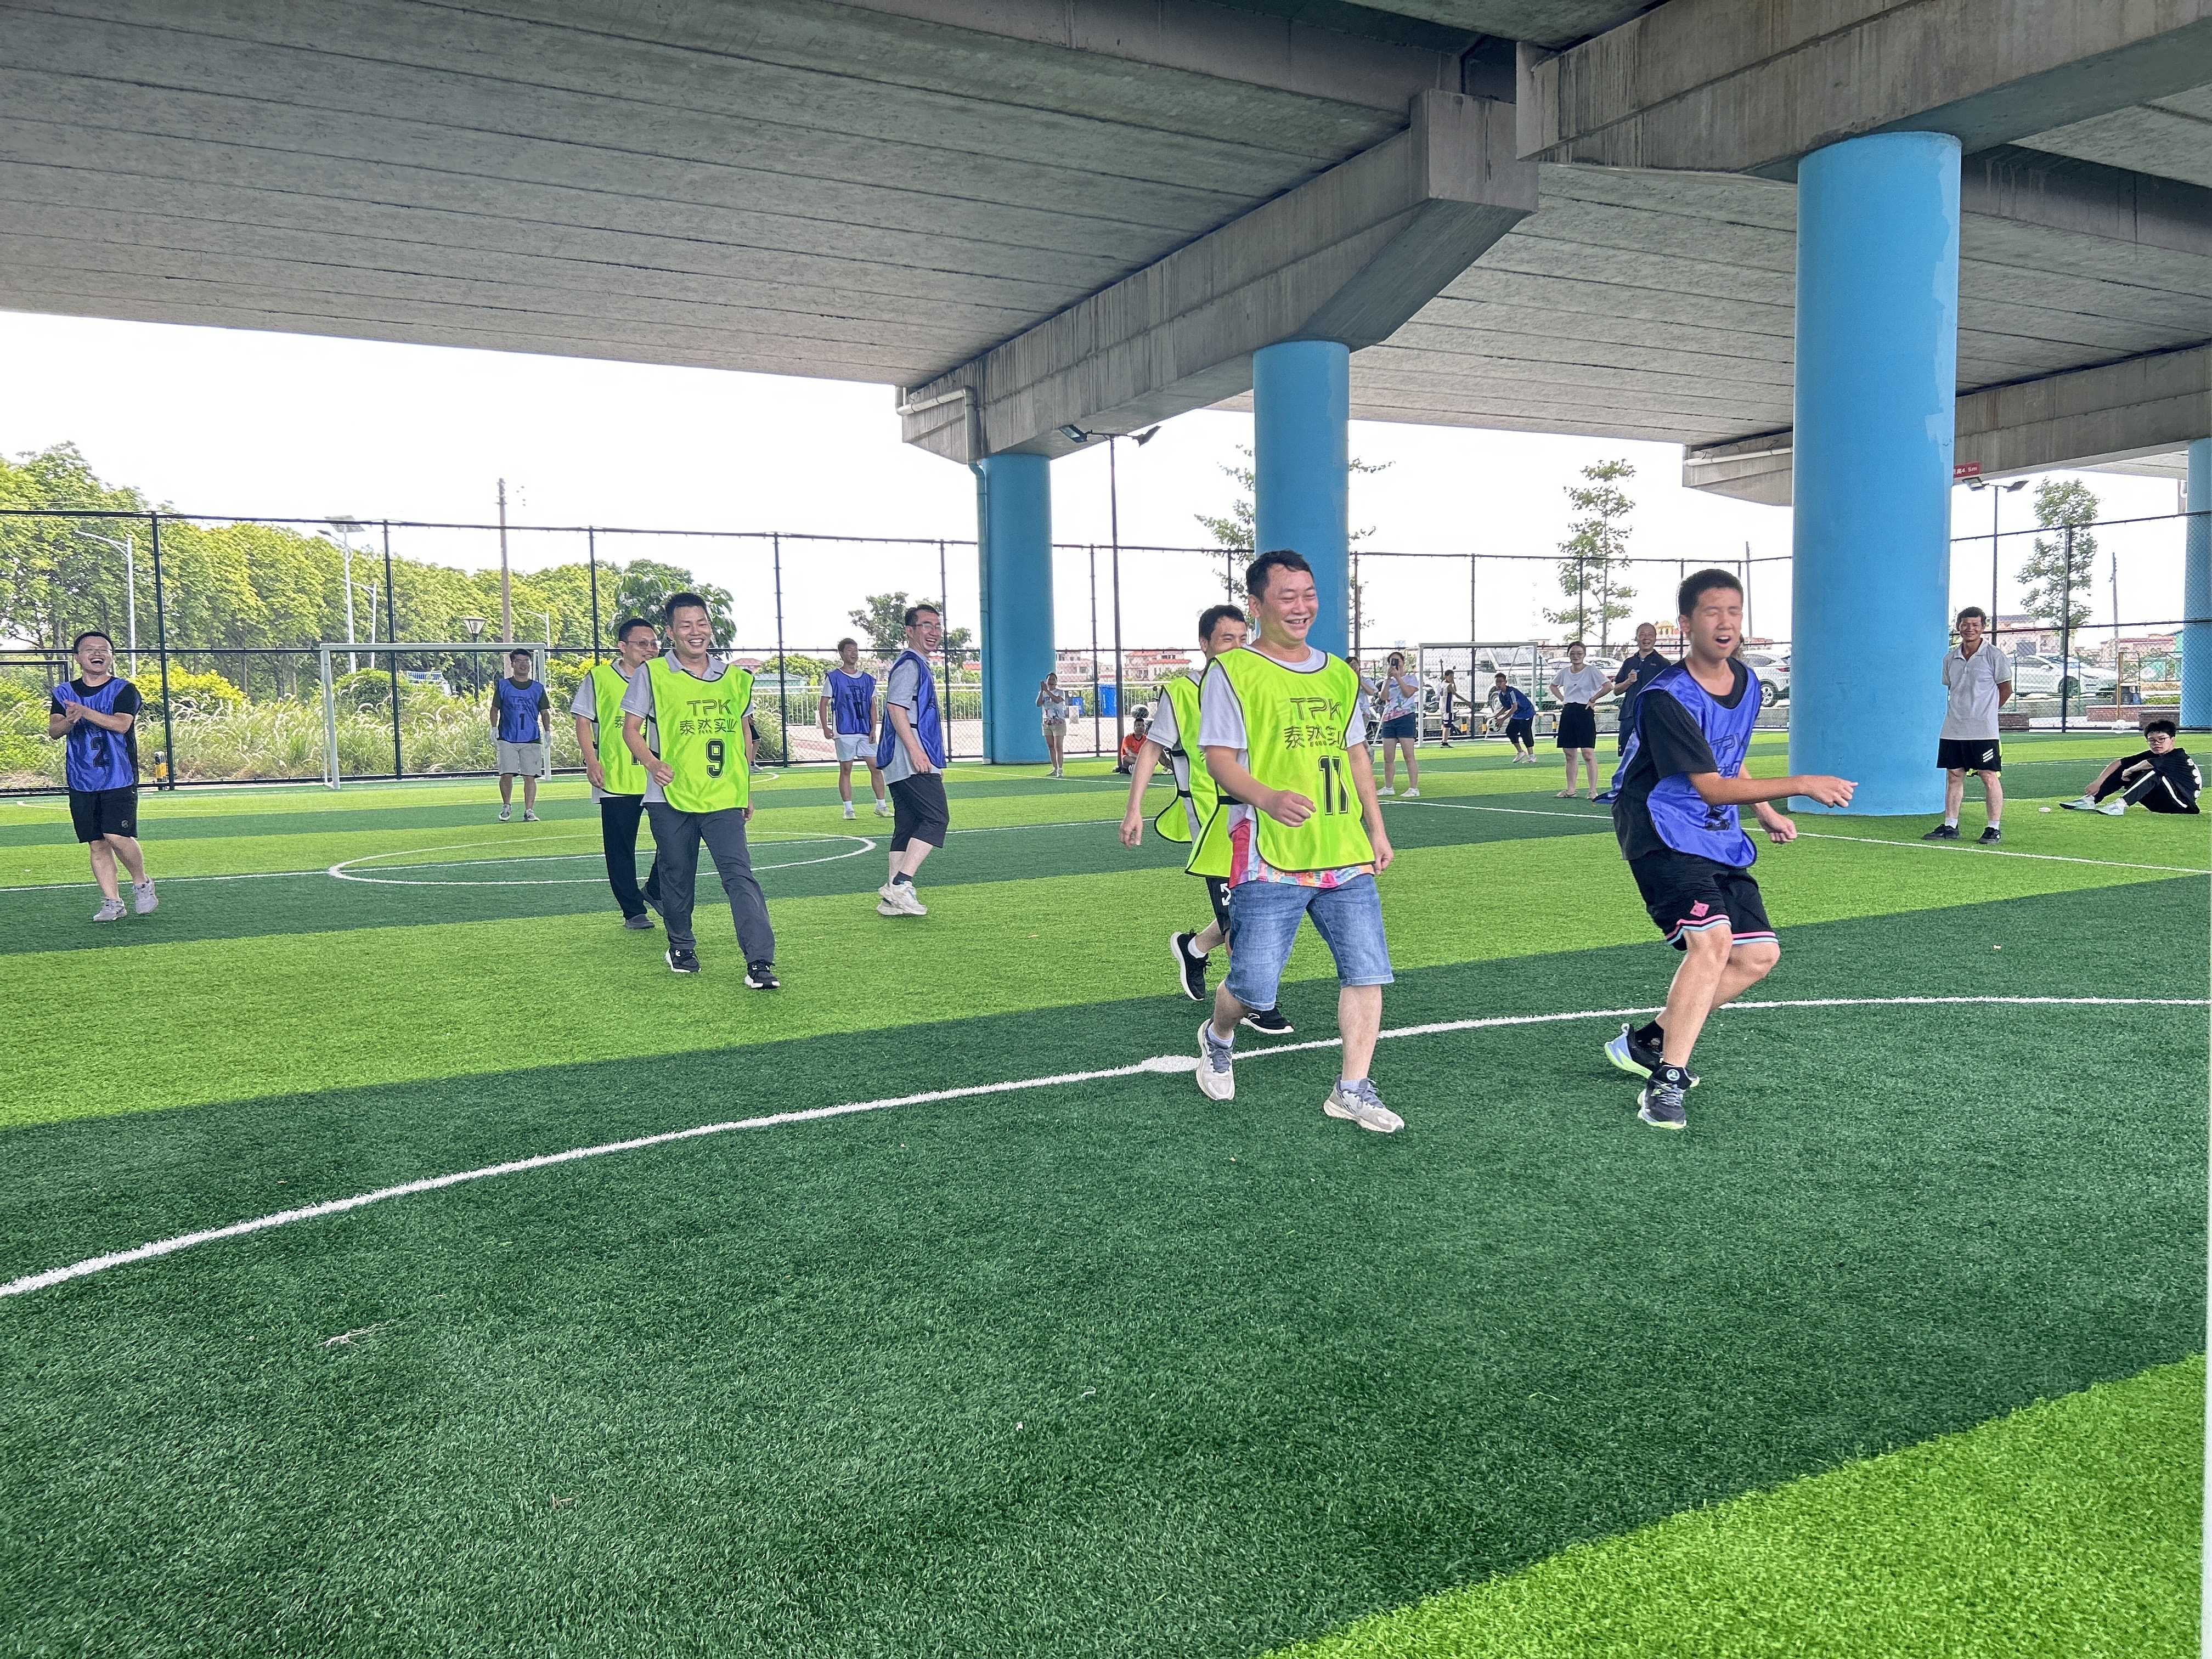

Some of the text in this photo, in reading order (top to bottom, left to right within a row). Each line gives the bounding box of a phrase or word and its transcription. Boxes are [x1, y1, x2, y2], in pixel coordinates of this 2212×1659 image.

[686, 698, 732, 716] TPK
[1290, 697, 1341, 720] TPK
[680, 718, 737, 736] 泰然实业
[706, 738, 725, 778] 9
